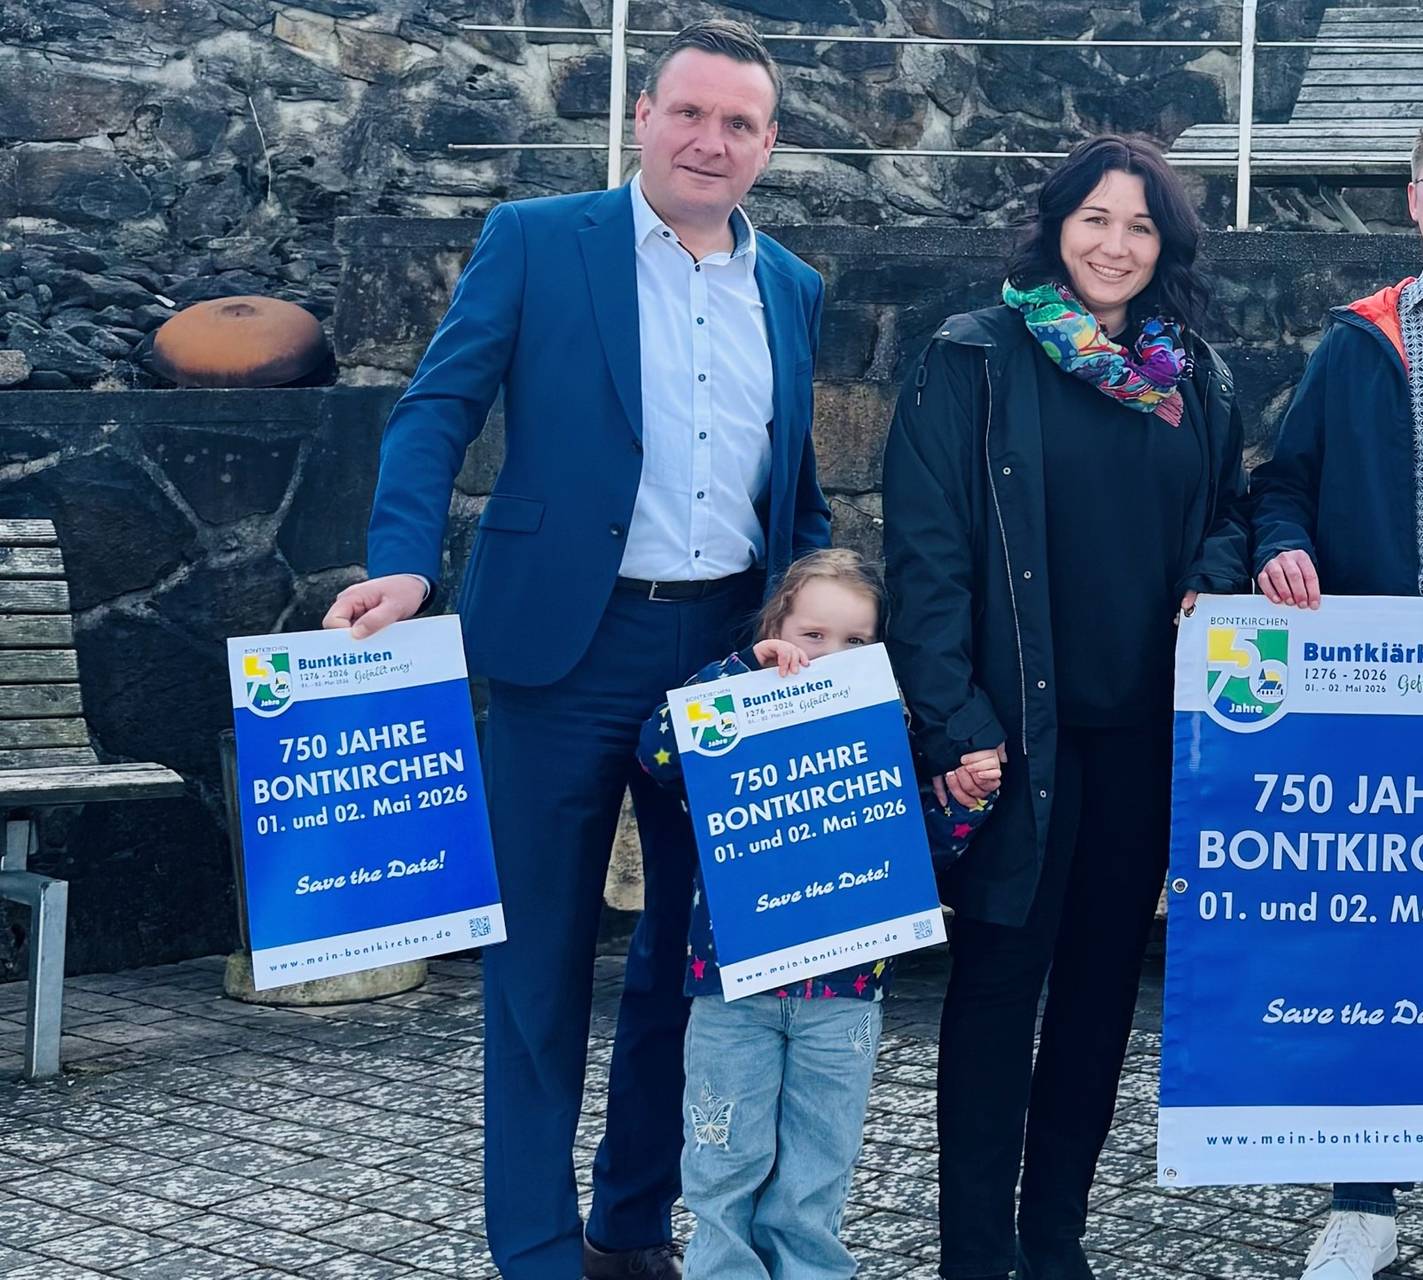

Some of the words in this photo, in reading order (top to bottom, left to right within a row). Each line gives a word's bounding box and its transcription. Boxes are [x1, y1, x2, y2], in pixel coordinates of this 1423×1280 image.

[1210, 616, 1288, 626] BONTKIRCHEN
[298, 650, 392, 670] Buntkiärken
[300, 672, 319, 681] 1276
[328, 669, 349, 678] 2026
[1304, 669, 1336, 680] 1276
[1354, 669, 1387, 681] 2026
[1229, 703, 1263, 714] Jahre
[1305, 684, 1319, 692] 01.
[1346, 684, 1362, 692] Mai
[1366, 685, 1386, 693] 2026
[745, 708, 766, 718] 1276
[774, 701, 794, 712] 2026
[279, 734, 328, 763] 750
[336, 720, 427, 756] JAHRE
[253, 749, 465, 804] BONTKIRCHEN
[730, 764, 778, 796] 750
[786, 741, 868, 782] JAHRE
[256, 816, 286, 835] 01.
[293, 807, 328, 830] und
[334, 802, 366, 823] 02.
[373, 793, 412, 818] Mai
[418, 784, 468, 810] 2026
[707, 766, 902, 837] BONTKIRCHEN
[1253, 774, 1334, 814] 750
[714, 843, 744, 864] 01.
[749, 830, 783, 854] und
[788, 823, 818, 844] 02.
[823, 811, 857, 835] Mai
[862, 798, 906, 825] 2026
[295, 874, 346, 896] Save
[350, 866, 382, 884] the
[387, 850, 446, 878] Date!
[756, 890, 802, 914] Save
[804, 879, 834, 899] the
[838, 860, 890, 890] Date!
[1198, 892, 1246, 920] 01.
[1260, 892, 1317, 922] und
[1330, 894, 1377, 923] 02.
[270, 930, 451, 972] www.mein-bontkirchen.de
[1262, 998, 1334, 1024] Save
[1341, 1003, 1386, 1024] the
